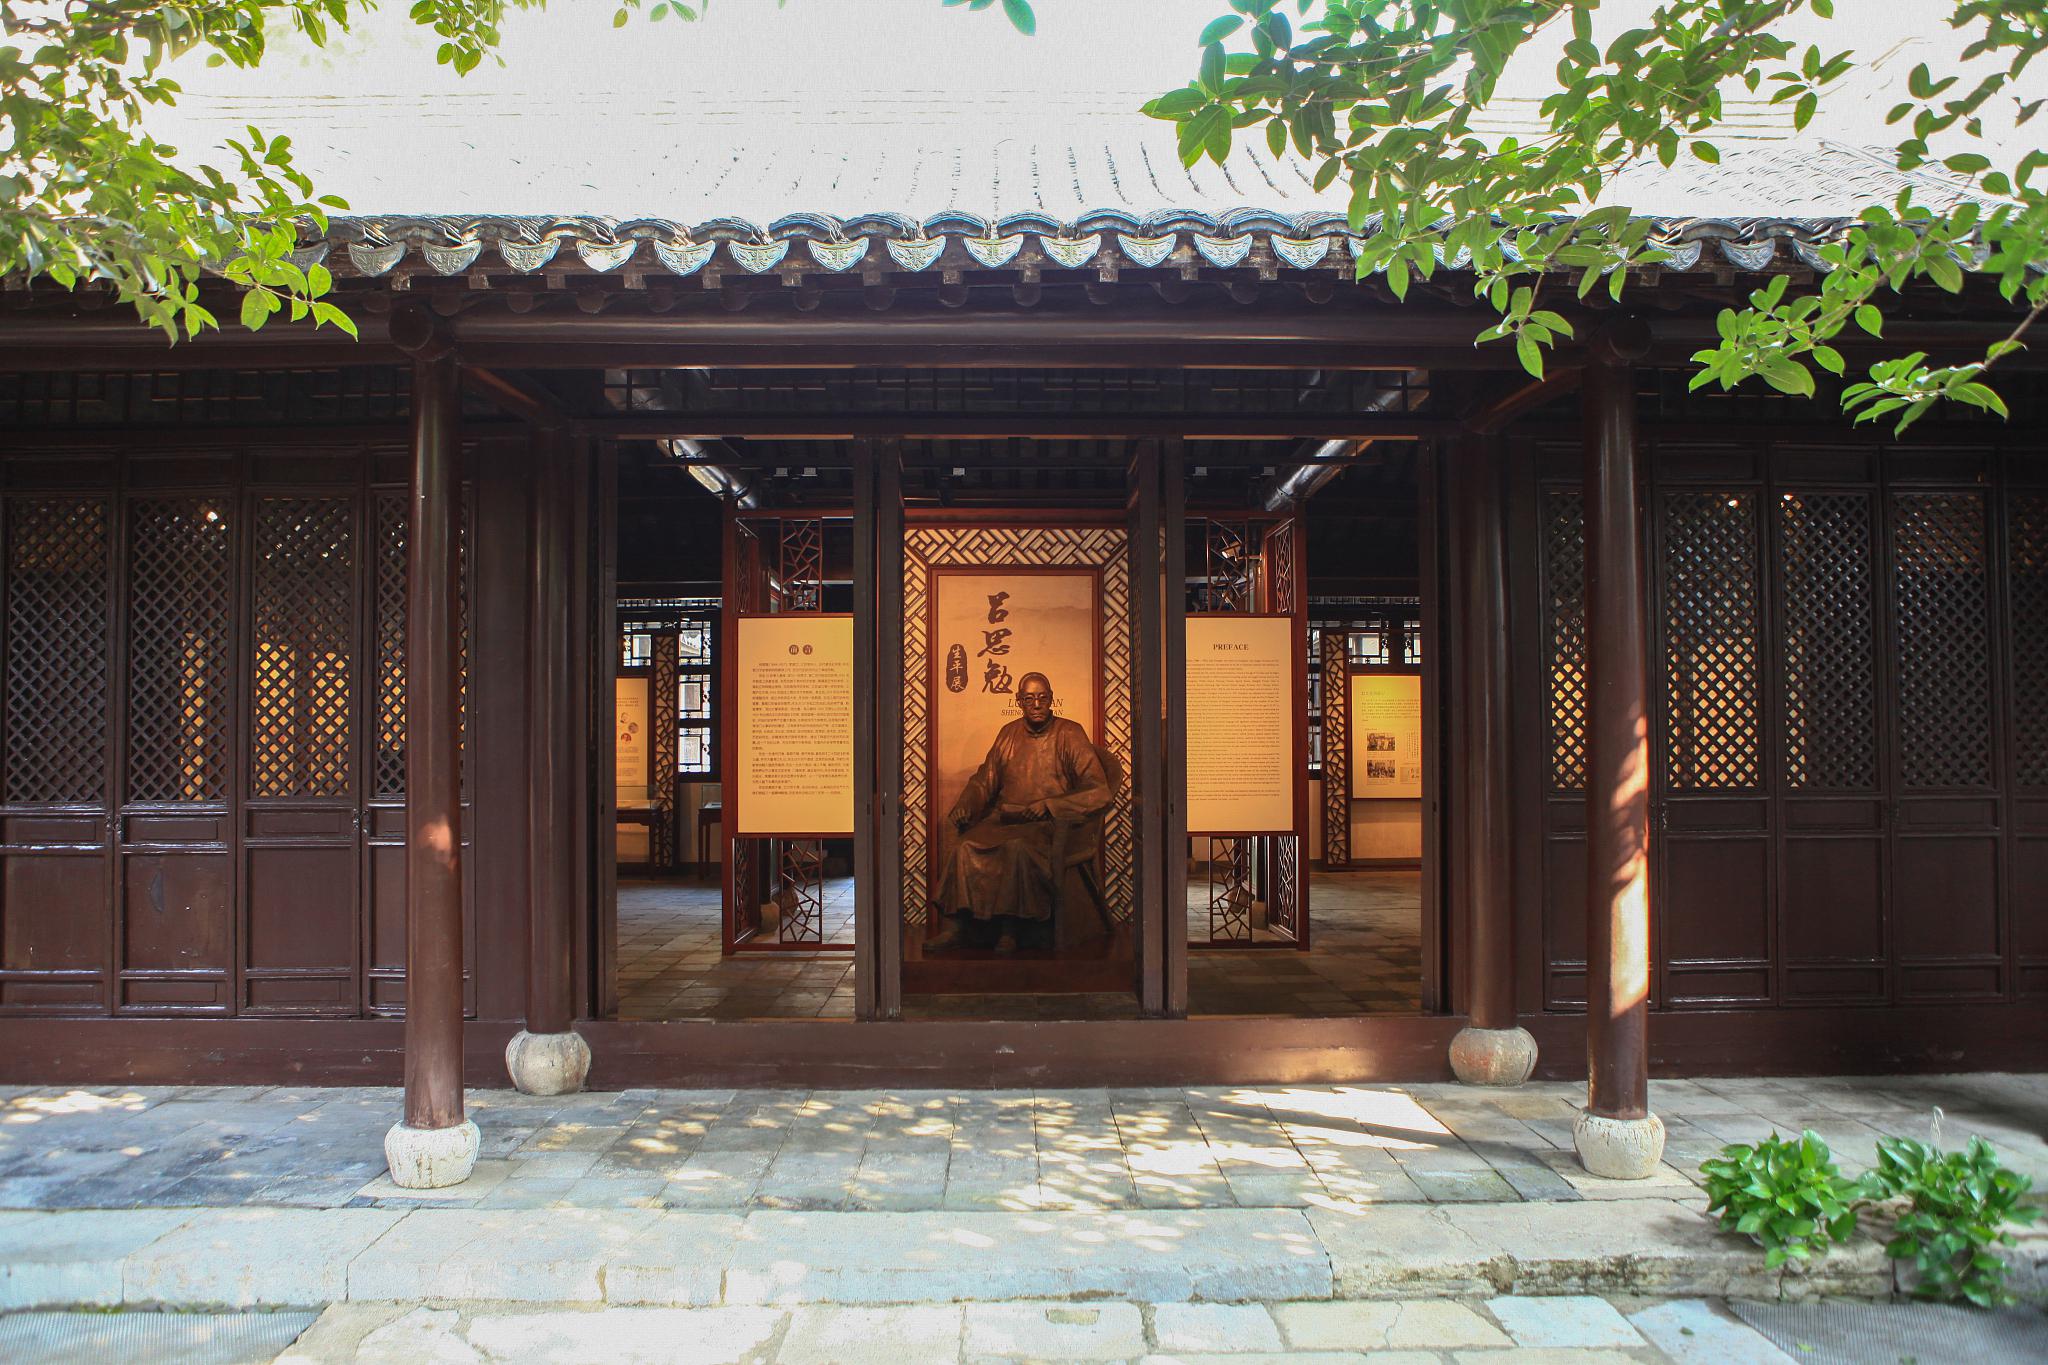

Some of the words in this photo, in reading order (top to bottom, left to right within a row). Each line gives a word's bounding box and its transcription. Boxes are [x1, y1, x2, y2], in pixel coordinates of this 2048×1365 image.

[1213, 643, 1250, 651] PREFACE
[949, 645, 965, 690] 生平展
